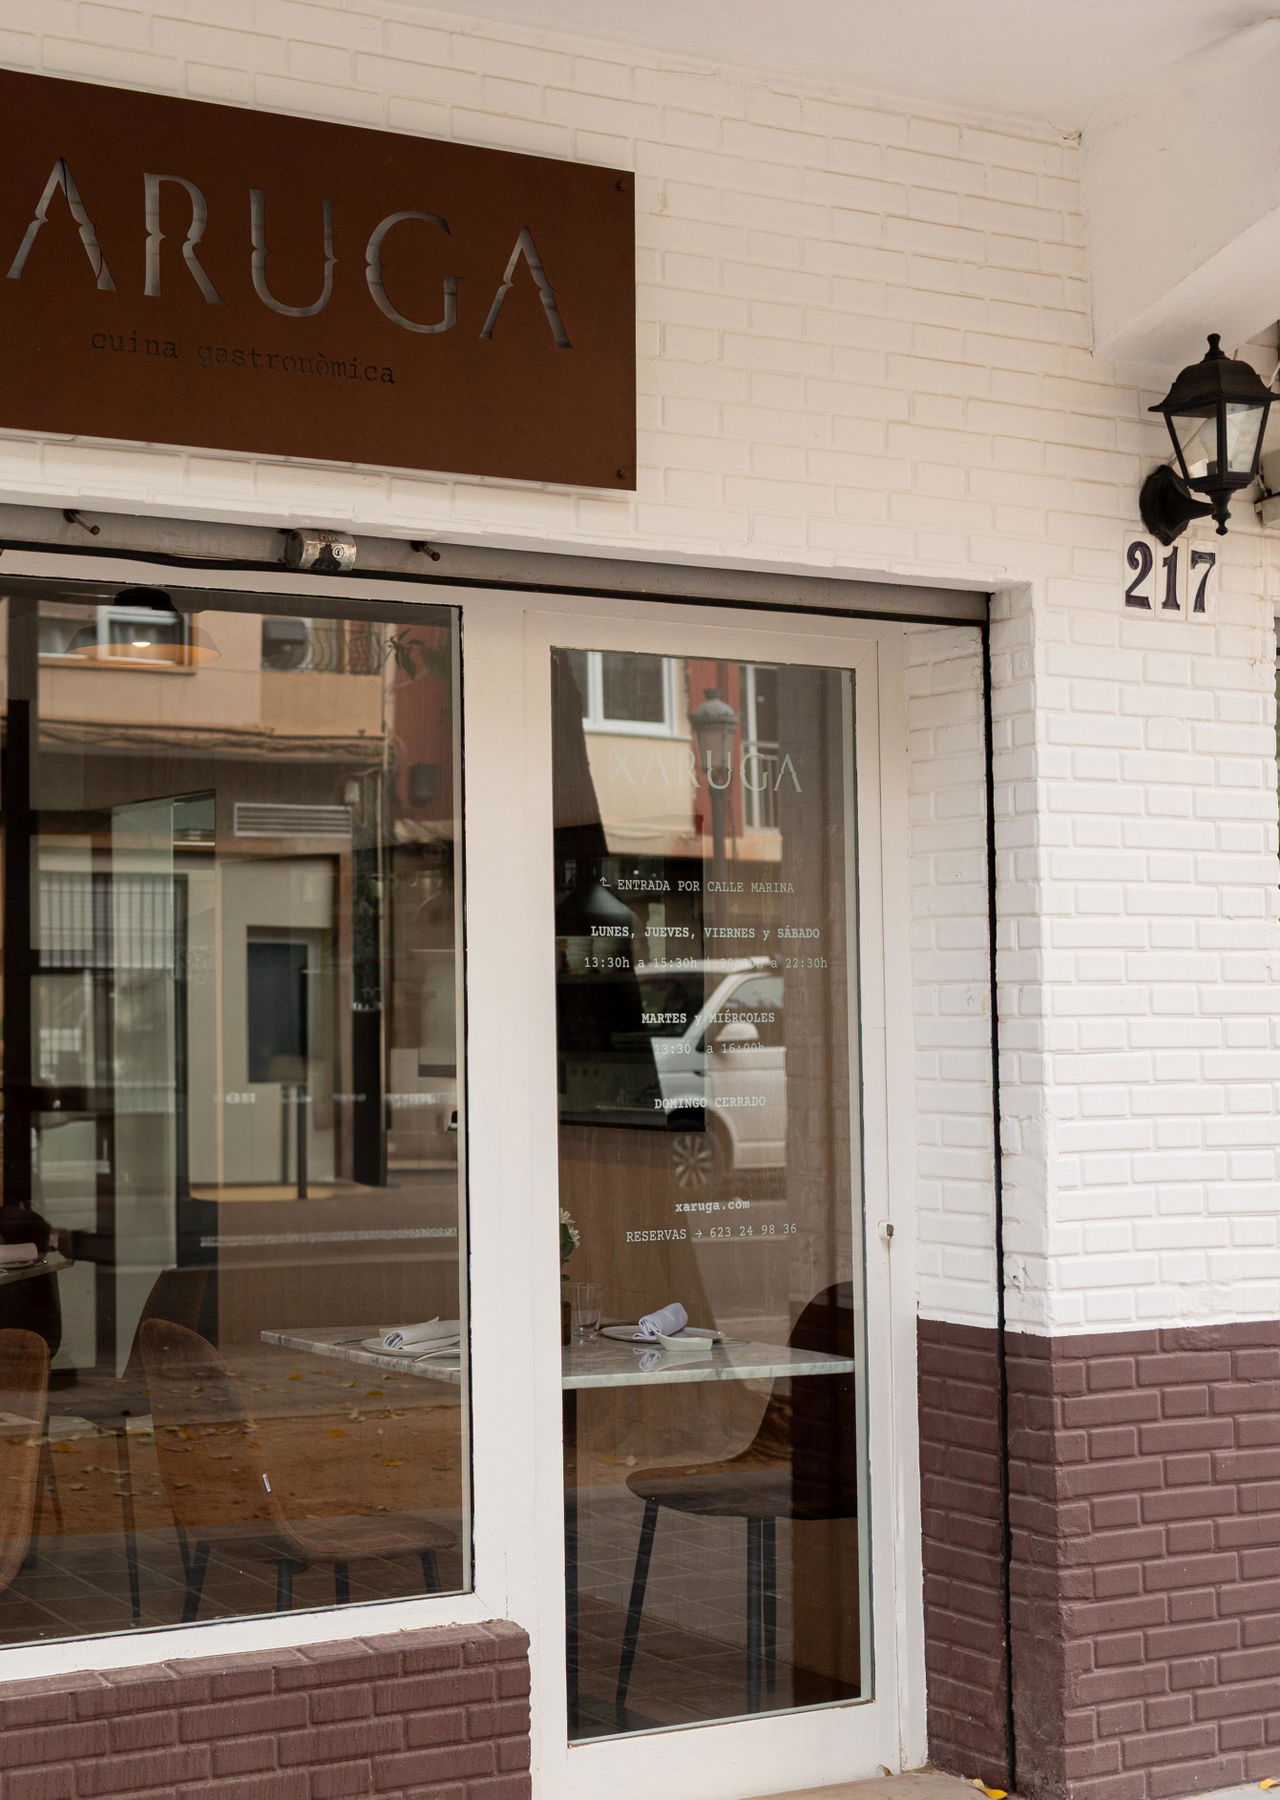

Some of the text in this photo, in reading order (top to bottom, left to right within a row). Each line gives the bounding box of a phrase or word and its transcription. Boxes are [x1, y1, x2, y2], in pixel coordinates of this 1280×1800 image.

[91, 331, 179, 359] cuina
[1124, 541, 1216, 613] 217
[608, 750, 802, 793] XARUGA
[617, 879, 795, 894] ENTRADA POR CALLE MARINA
[590, 924, 821, 941] LUNES, JUEVES, VIERNES y SÁBADO
[584, 957, 630, 969] 13:30h
[637, 959, 646, 969] a
[653, 957, 698, 969] 15:30h
[770, 959, 778, 969] a
[785, 957, 828, 969] 22:30h
[641, 1013, 688, 1024] MARTES
[708, 1009, 775, 1024] MIÉRCOLES
[706, 1045, 714, 1055] a
[654, 1096, 767, 1110] DOMINGO CERRADO
[675, 1199, 750, 1214] xaruga.com
[626, 1222, 798, 1243] RESERVAS 623 24 98 36
